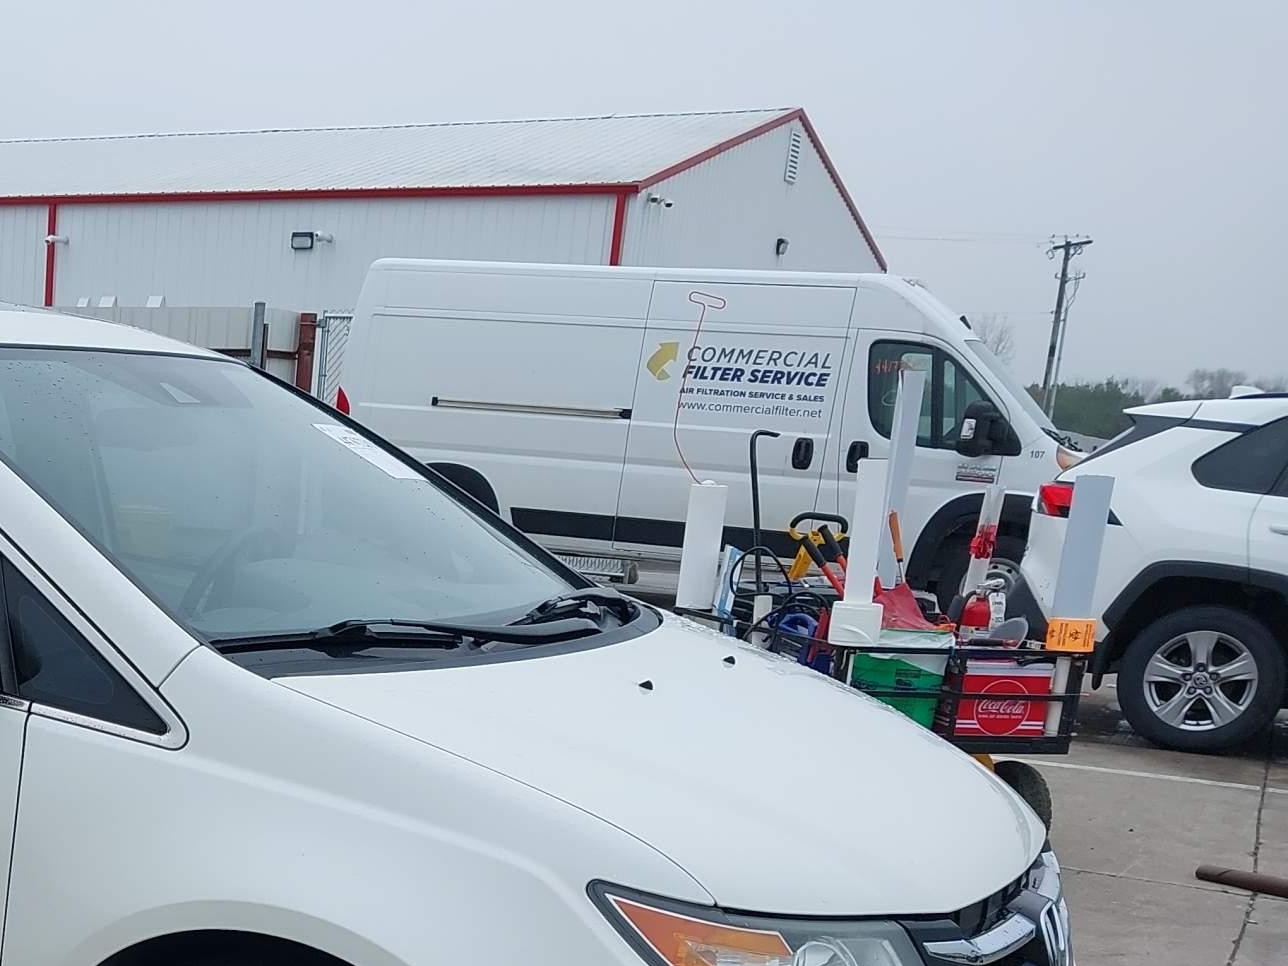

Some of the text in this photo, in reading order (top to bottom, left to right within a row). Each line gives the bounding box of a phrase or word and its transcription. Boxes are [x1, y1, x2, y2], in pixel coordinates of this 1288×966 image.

[687, 346, 832, 370] COMMERCIAL
[682, 365, 831, 388] FILTER SERVICE
[679, 387, 694, 395] AIR
[696, 387, 746, 398] FILTRATION
[748, 391, 786, 401] SERVICE
[796, 394, 825, 403] SALES
[678, 400, 822, 418] www.commercialfilter.net
[1030, 450, 1046, 460] 107
